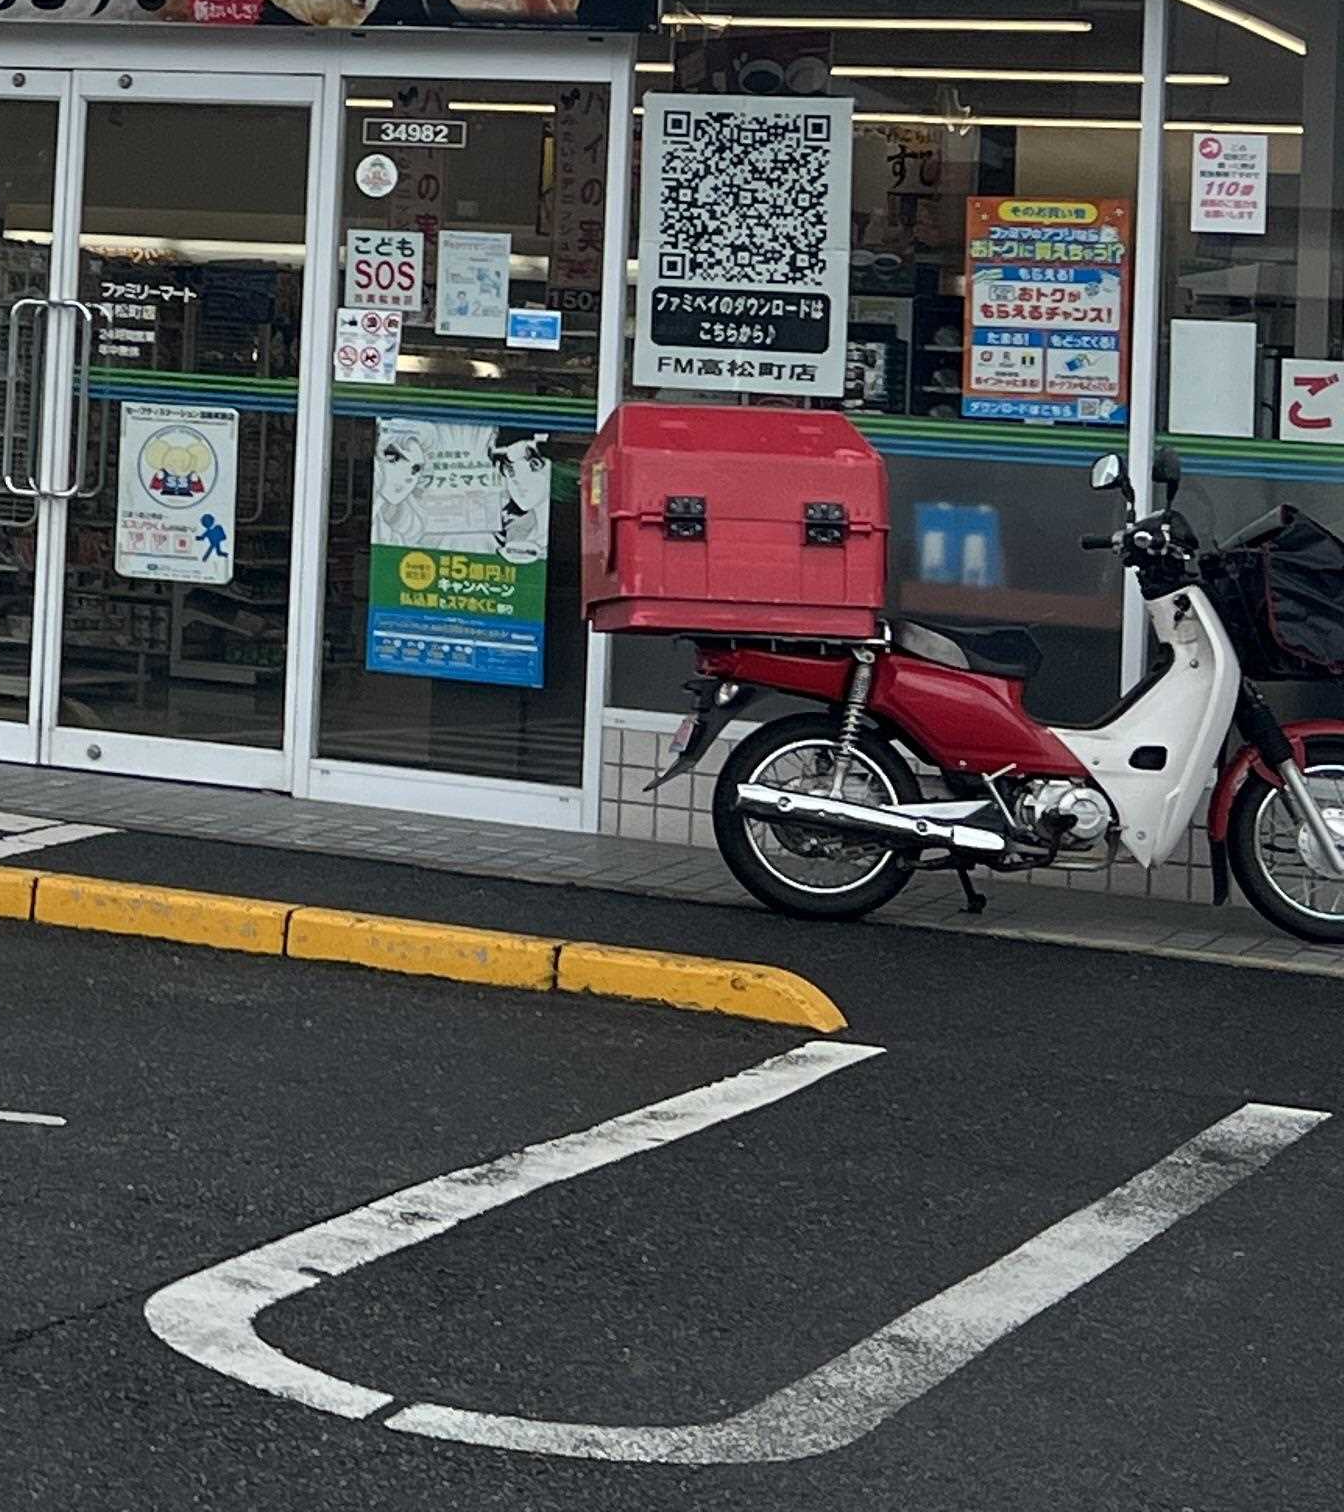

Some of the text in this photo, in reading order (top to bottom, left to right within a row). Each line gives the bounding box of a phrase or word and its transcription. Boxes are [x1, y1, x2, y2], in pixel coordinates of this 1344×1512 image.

[380, 122, 450, 143] 34982
[354, 236, 415, 258] こども
[354, 259, 415, 292] SOS
[100, 282, 198, 303] ファミリーマート
[1017, 286, 1082, 304] おトクが
[655, 292, 825, 320] ファミペイのダウンロードは
[980, 303, 1113, 324] もらえるチャンス!
[986, 331, 1031, 346] たまる!
[657, 355, 819, 383] FM高松町店
[969, 401, 1074, 418] ダウンロードはこちら
[1288, 373, 1341, 430] ご
[437, 578, 515, 598] キャンペーン
